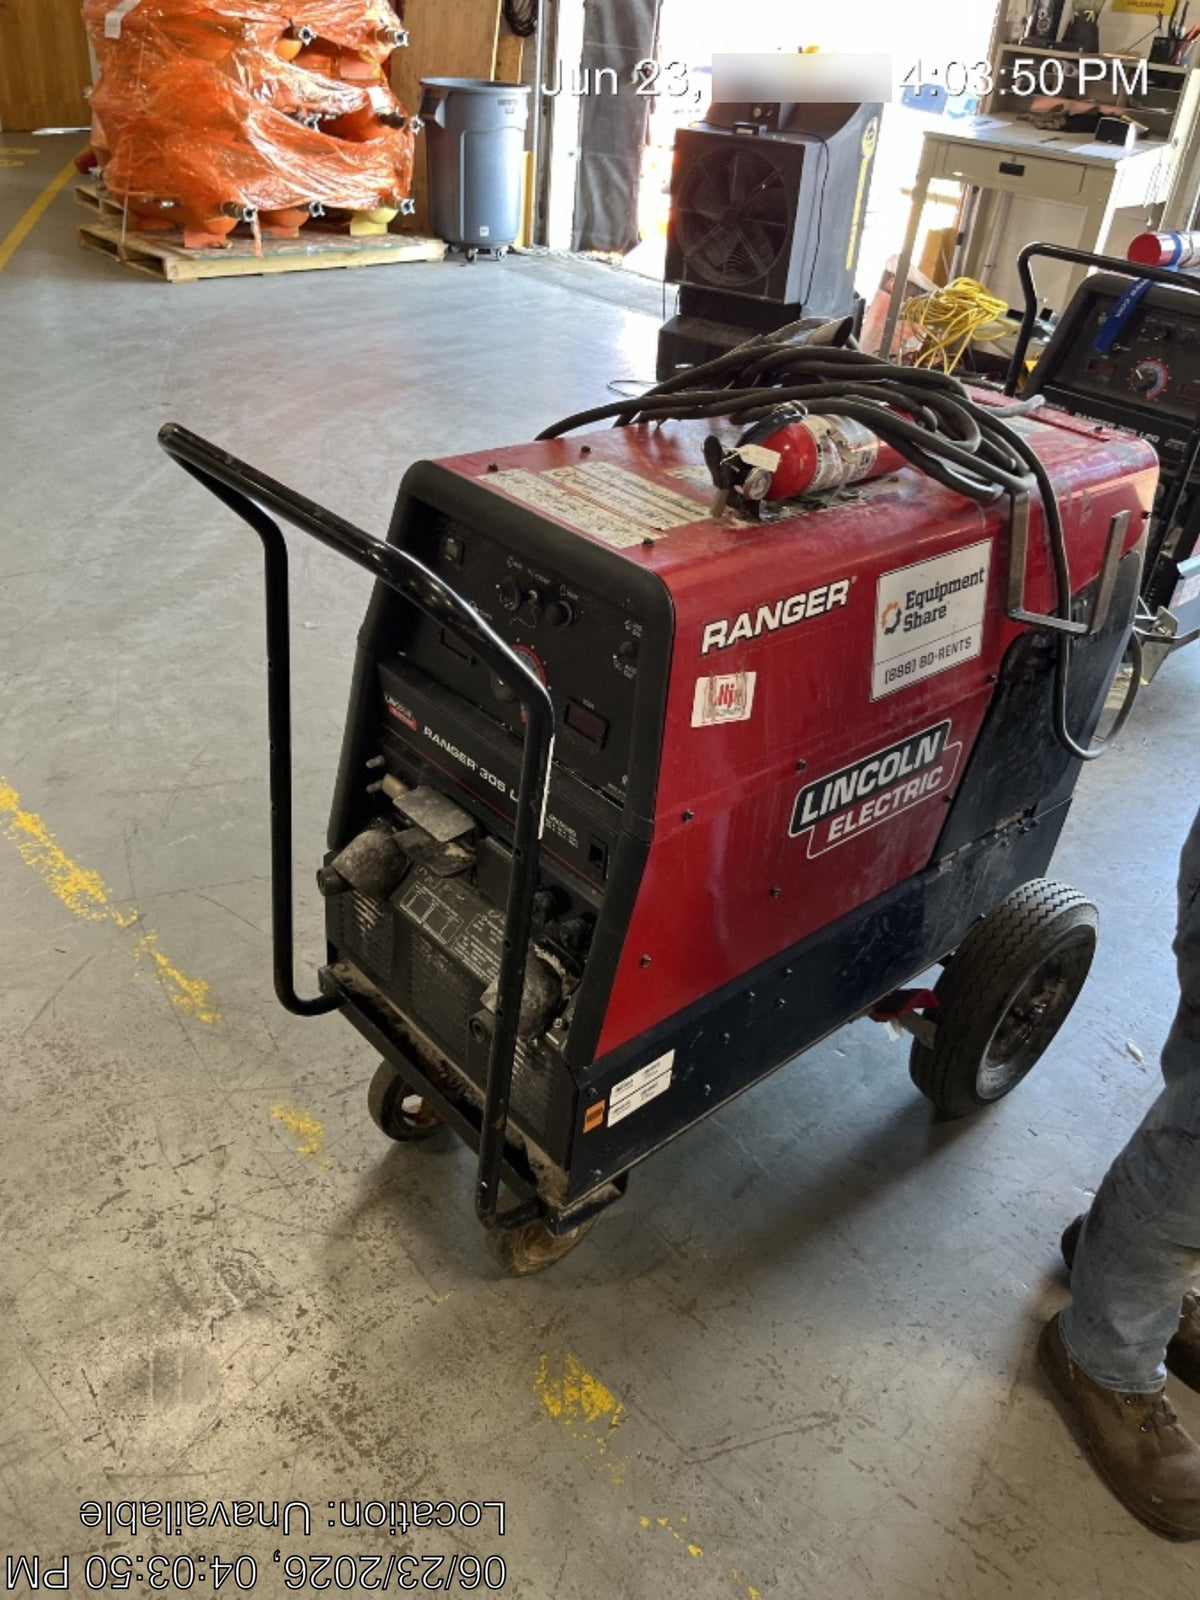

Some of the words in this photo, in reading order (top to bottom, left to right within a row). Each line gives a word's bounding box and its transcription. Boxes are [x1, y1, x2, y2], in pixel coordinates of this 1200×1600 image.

[905, 566, 986, 611] Equipment
[700, 578, 851, 656] RANGER
[902, 605, 947, 634] Share
[918, 636, 972, 669] 80-RENTS
[423, 725, 476, 771] RANGER
[800, 730, 942, 826] LINCOLN
[826, 765, 944, 843] ELECTRIC
